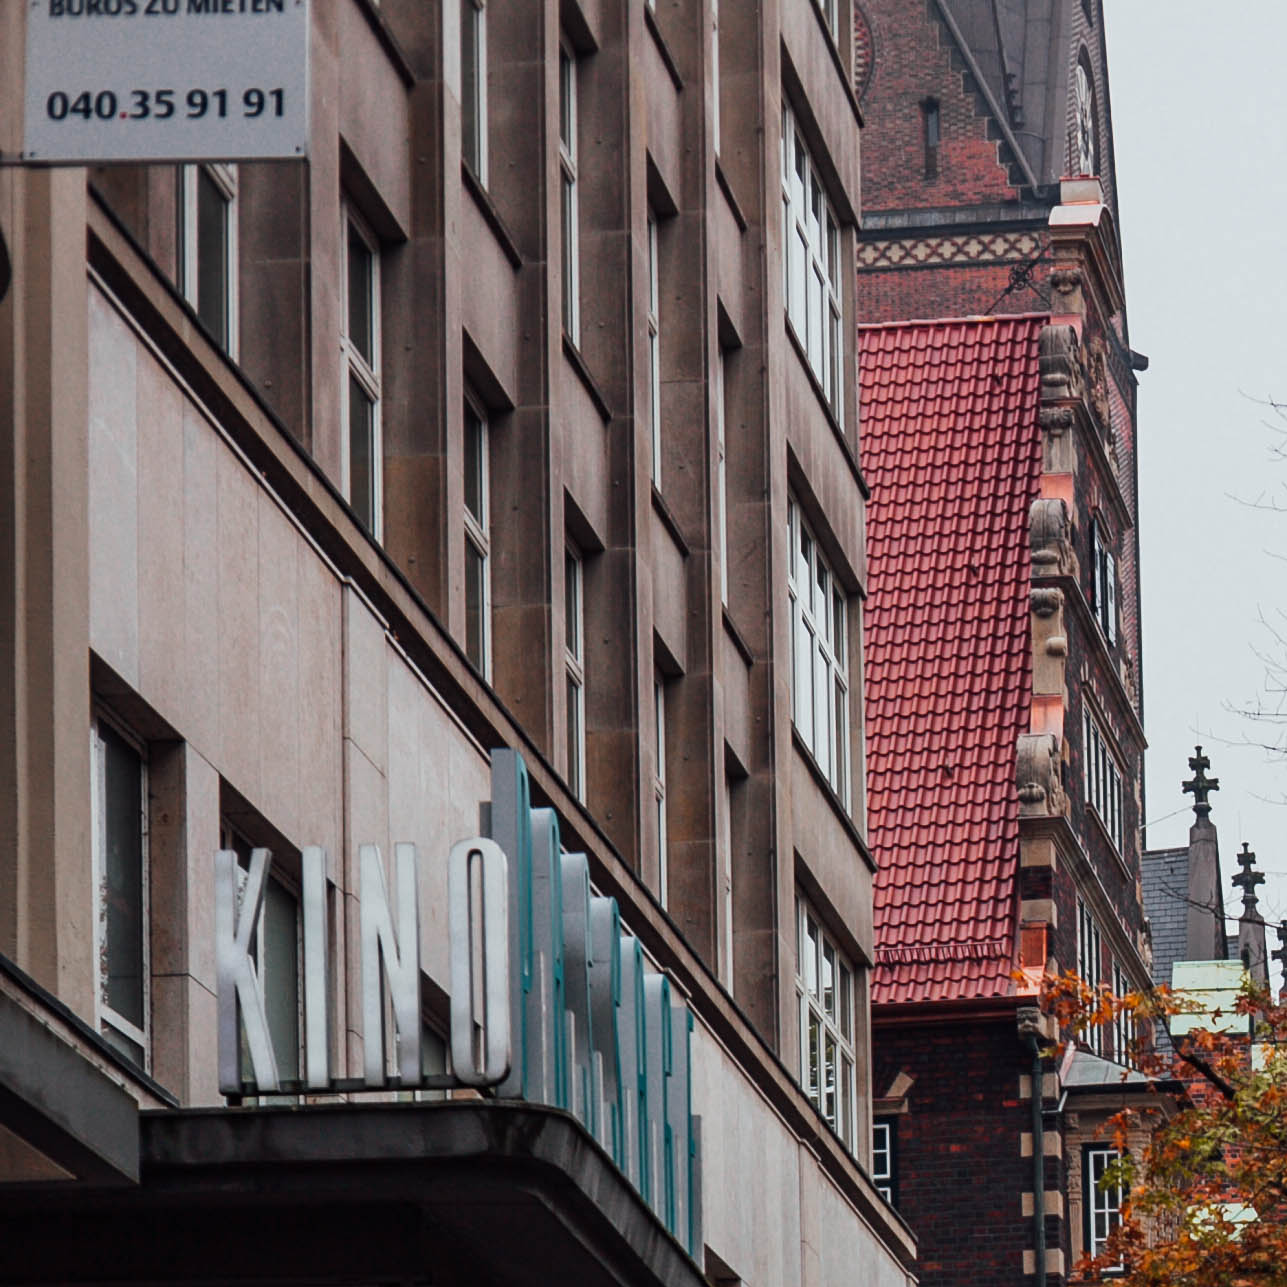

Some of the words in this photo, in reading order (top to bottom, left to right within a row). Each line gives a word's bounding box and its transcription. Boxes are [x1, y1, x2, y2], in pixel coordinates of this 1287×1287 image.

[46, 90, 175, 119] 040.35
[187, 88, 228, 118] 91
[243, 87, 285, 118] 91
[214, 836, 512, 1095] KINO
